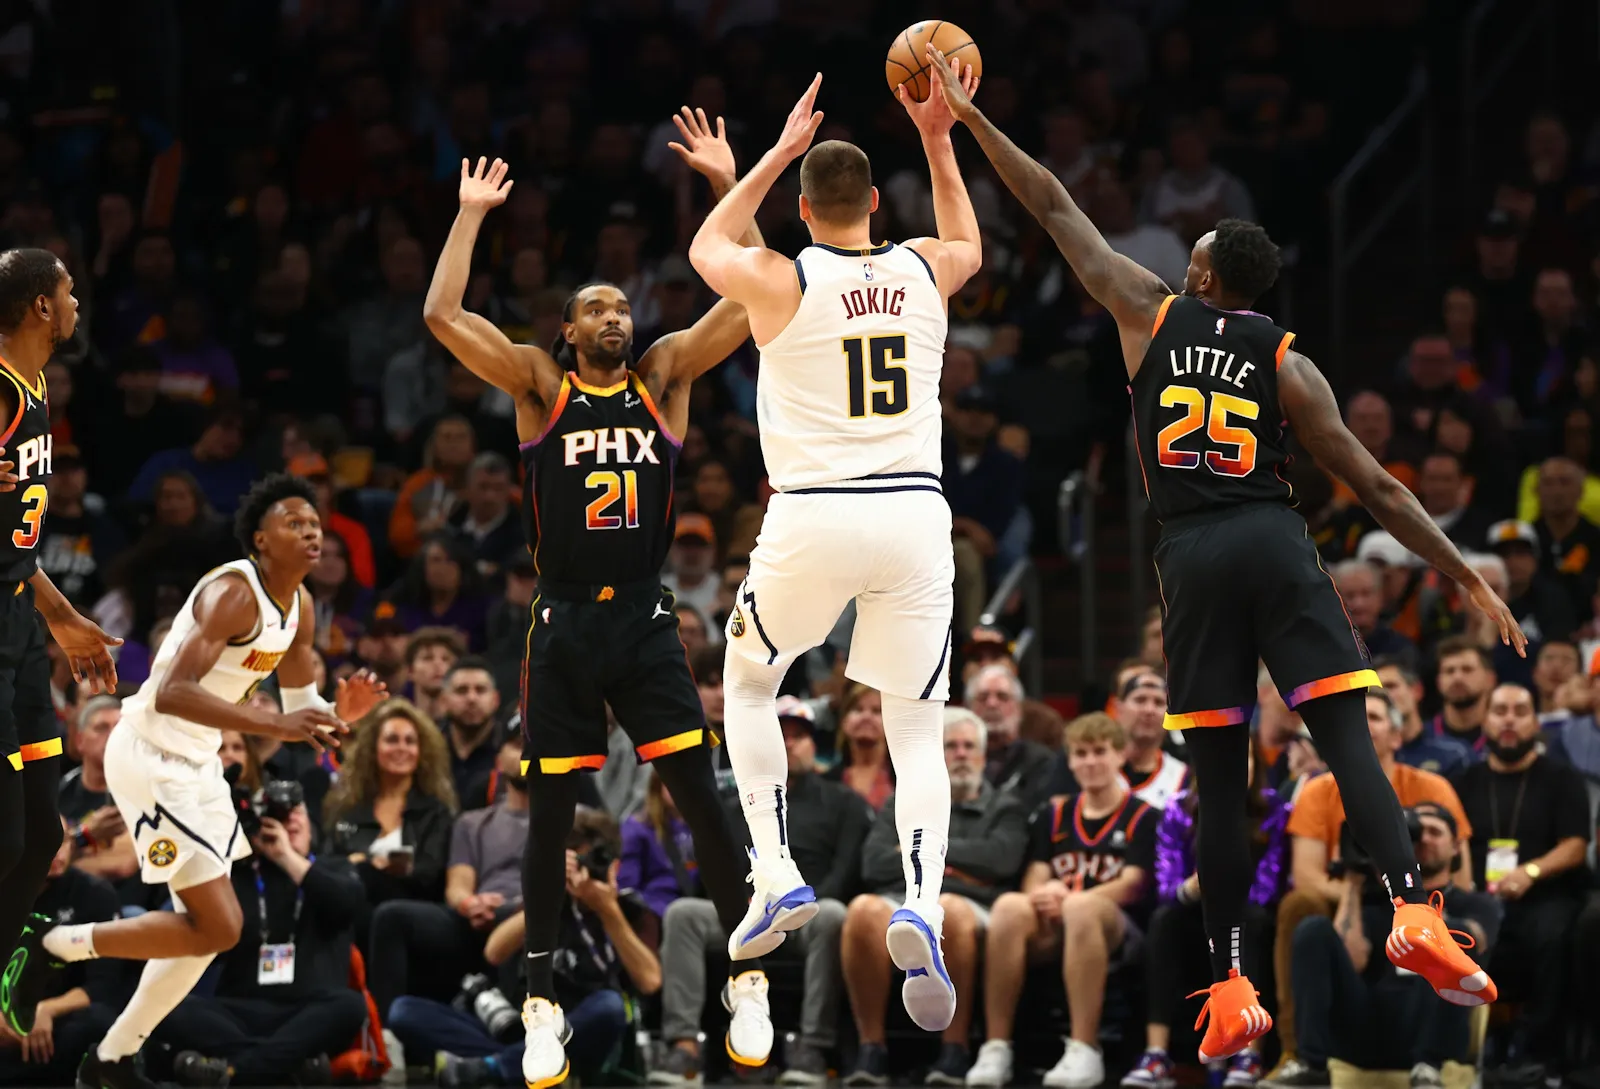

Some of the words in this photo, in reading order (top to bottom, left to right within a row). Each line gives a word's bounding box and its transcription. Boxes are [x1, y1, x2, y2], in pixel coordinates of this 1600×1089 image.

[841, 286, 905, 320] JOKIĆ
[841, 333, 910, 420] 15
[1169, 346, 1256, 389] LITTLE
[561, 427, 660, 466] PHX
[1157, 384, 1260, 477] 25
[12, 484, 48, 549] 3
[584, 470, 640, 530] 21
[1052, 851, 1125, 882] PHX
